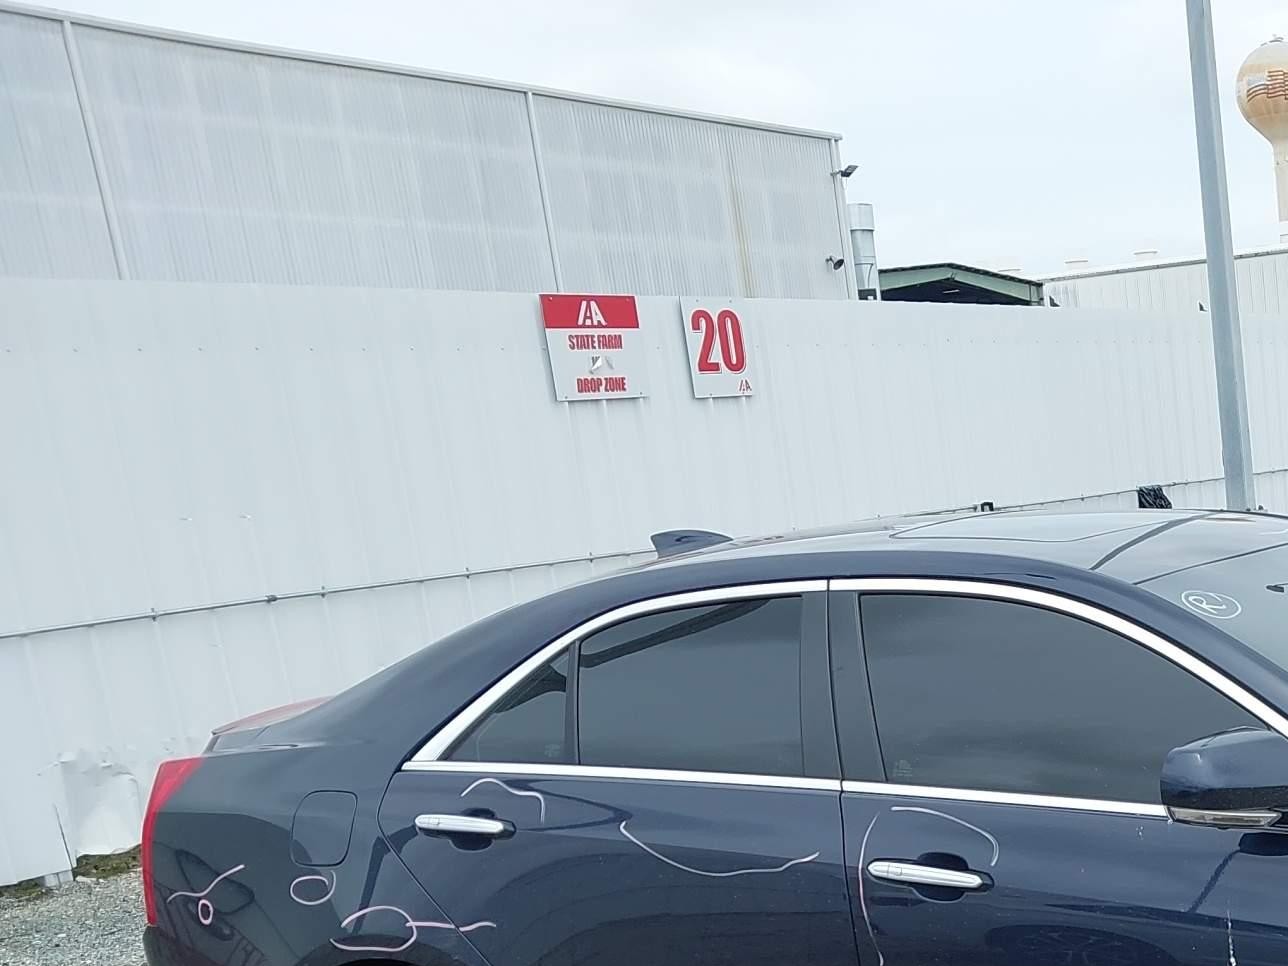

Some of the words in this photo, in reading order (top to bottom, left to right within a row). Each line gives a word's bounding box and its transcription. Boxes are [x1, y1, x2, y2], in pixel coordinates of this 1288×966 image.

[568, 334, 597, 350] STATE
[597, 334, 623, 350] FARM
[690, 308, 747, 374] 20
[577, 377, 603, 393] DROP
[604, 376, 627, 392] ZONE
